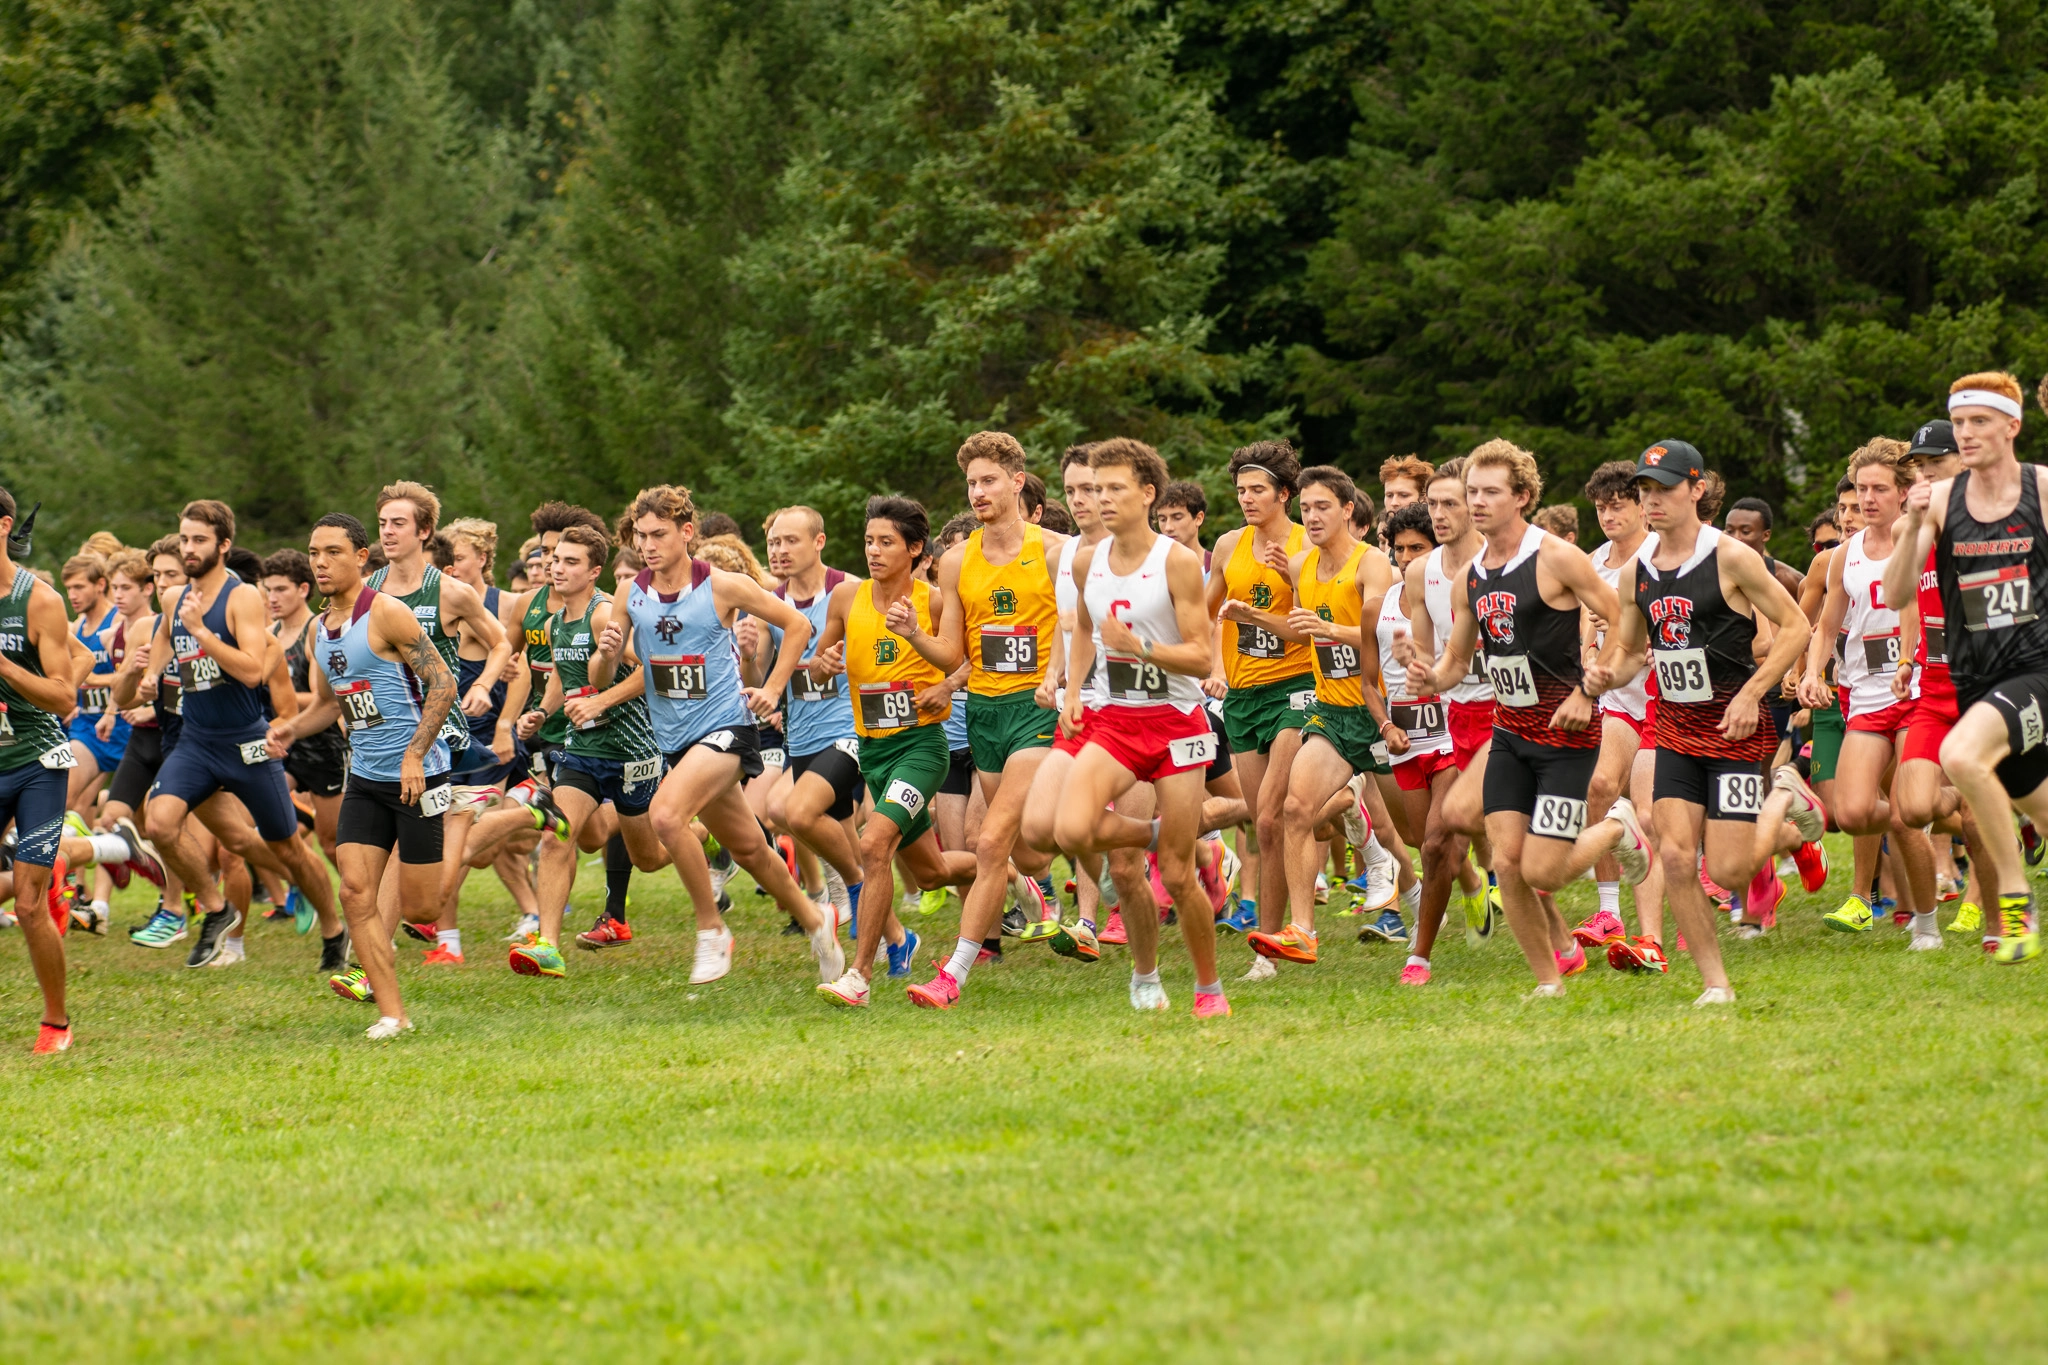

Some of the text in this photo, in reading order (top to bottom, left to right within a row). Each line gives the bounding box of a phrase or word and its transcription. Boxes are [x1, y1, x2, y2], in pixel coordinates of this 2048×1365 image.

[1952, 537, 2034, 556] ROBERTS
[1476, 591, 1516, 623] RIT
[1650, 596, 1693, 622] RIT
[1983, 579, 2030, 616] 247
[1005, 636, 1031, 662] 35
[1256, 625, 1278, 650] 53
[1887, 636, 1901, 662] 8
[191, 655, 221, 682] 289
[1332, 645, 1357, 669] 59
[669, 665, 705, 690] 131
[1130, 663, 1161, 690] 73
[1490, 666, 1531, 696] 894
[1659, 659, 1705, 692] 893
[345, 691, 378, 719] 138
[884, 691, 910, 718] 69
[1410, 703, 1438, 729] 70
[2025, 711, 2040, 742] 247
[1186, 740, 1206, 759] 73
[633, 762, 656, 778] 207
[901, 788, 918, 808] 69
[1540, 799, 1584, 835] 894
